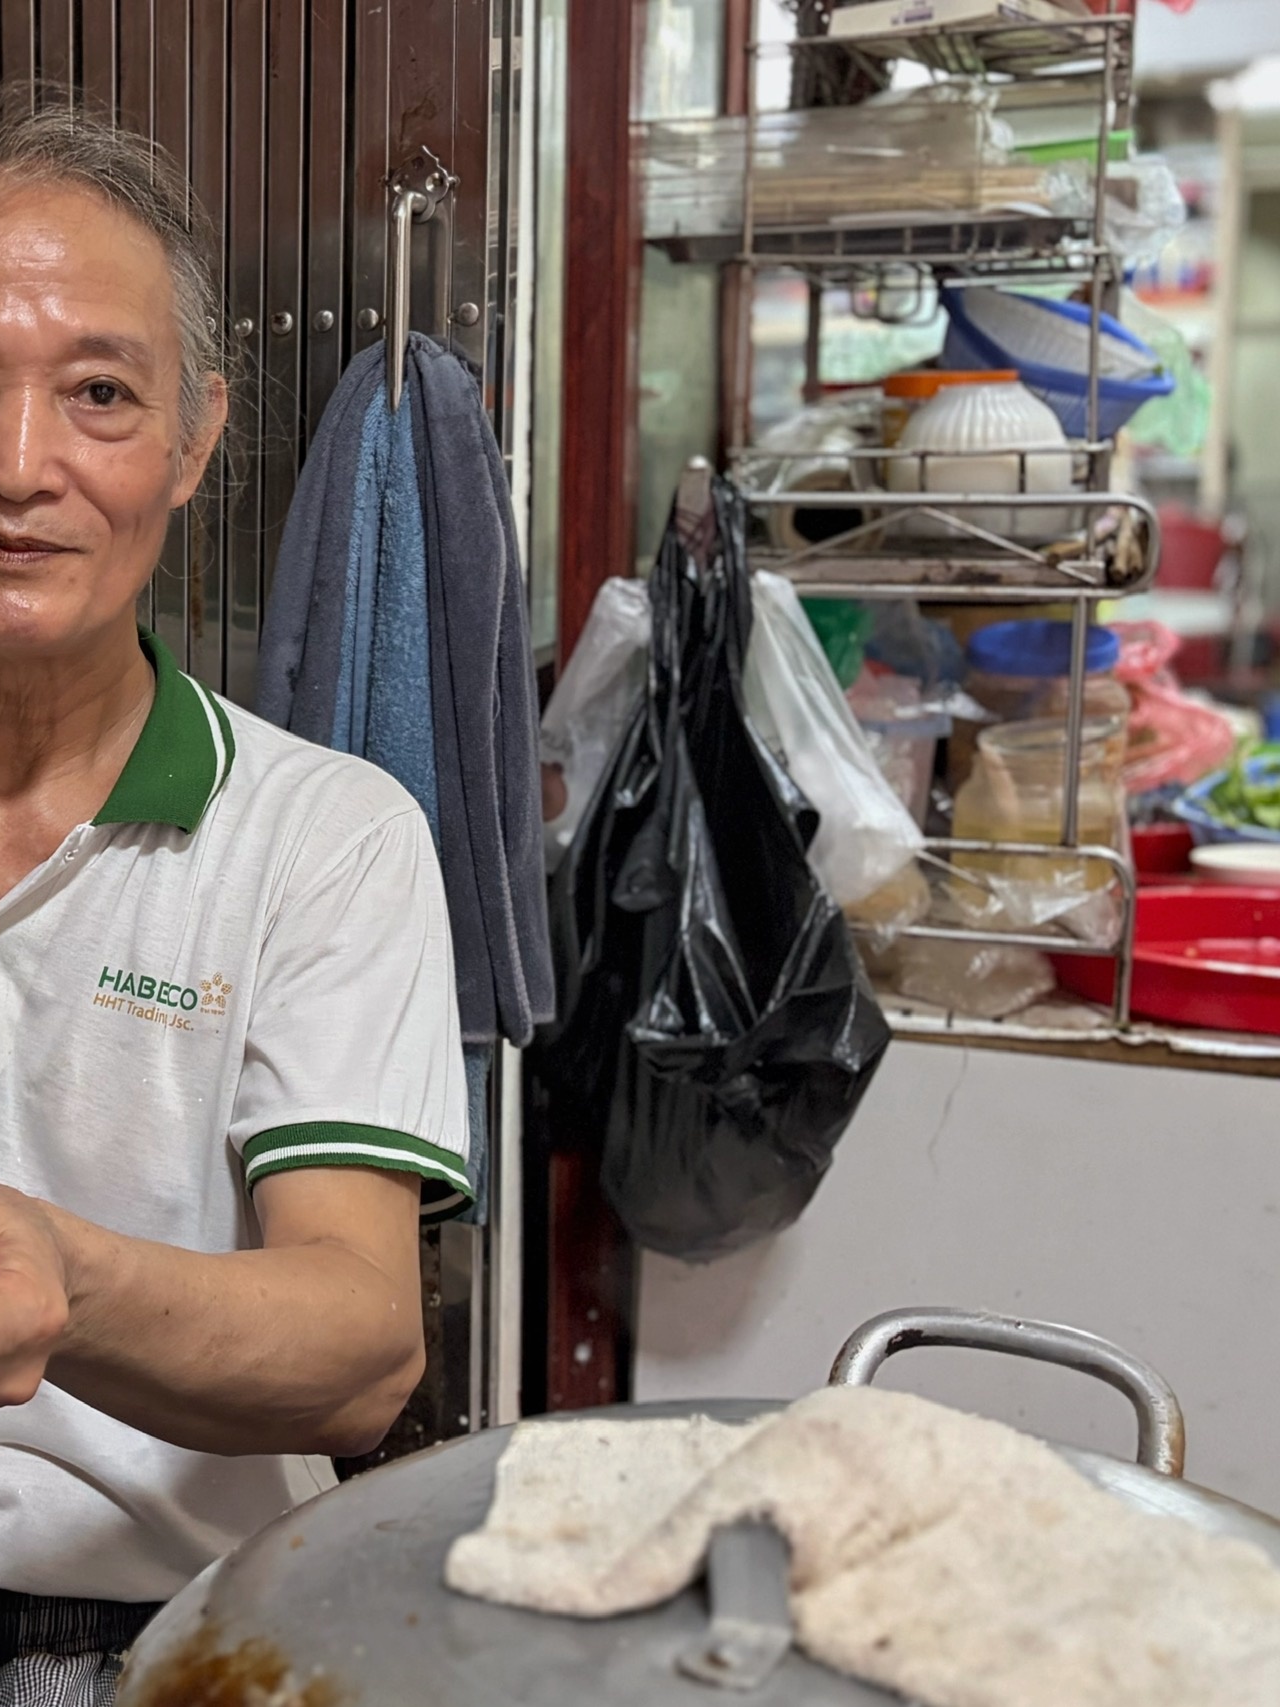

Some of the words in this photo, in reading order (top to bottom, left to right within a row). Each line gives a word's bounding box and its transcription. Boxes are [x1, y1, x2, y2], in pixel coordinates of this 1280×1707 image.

[98, 966, 198, 1011] HABECO
[93, 993, 124, 1011] HHT
[169, 1014, 195, 1031] Jsc.
